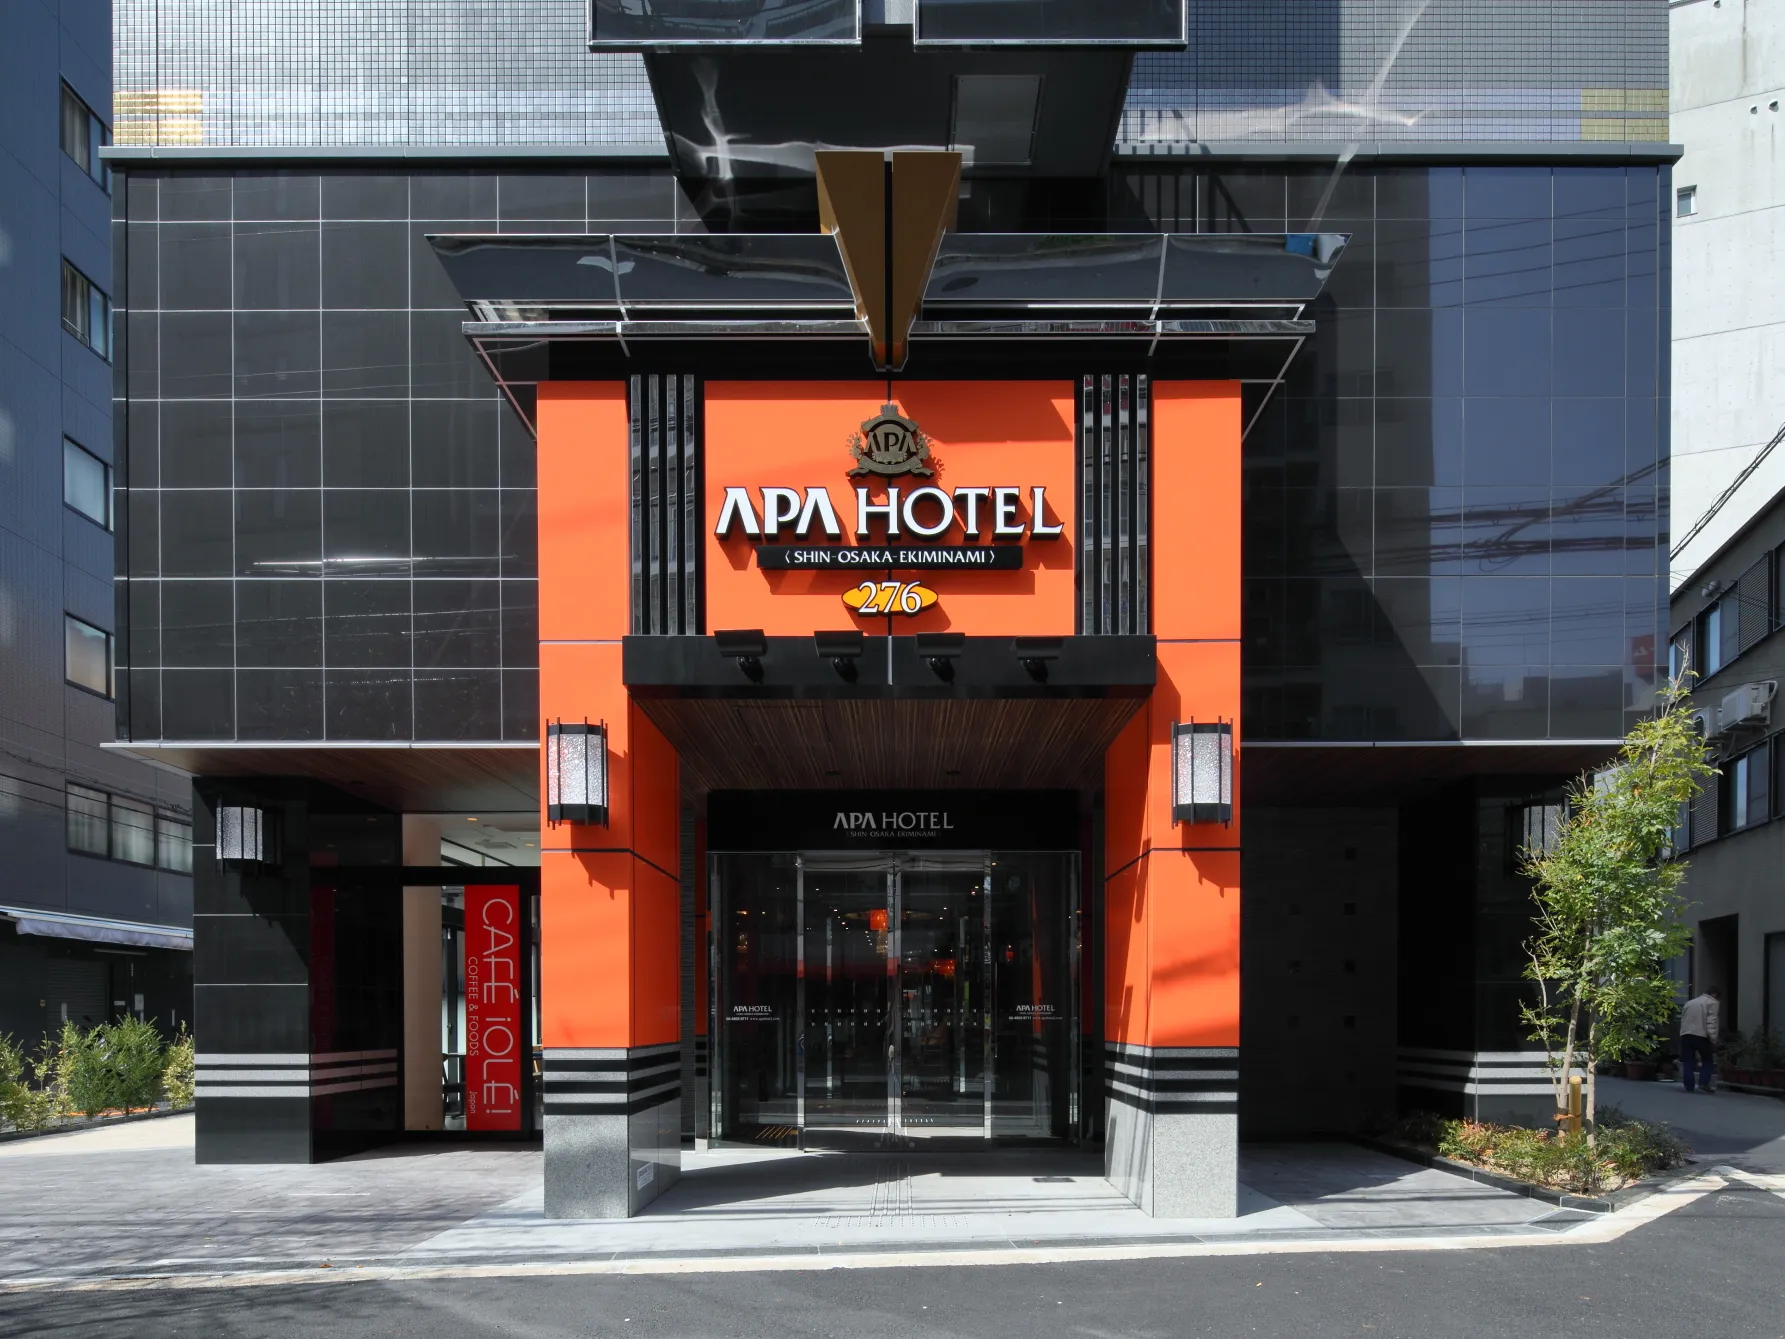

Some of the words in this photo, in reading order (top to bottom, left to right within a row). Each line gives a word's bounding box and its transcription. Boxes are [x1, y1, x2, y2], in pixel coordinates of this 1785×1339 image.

[864, 431, 917, 453] APA
[715, 486, 842, 537] APA
[855, 485, 1065, 538] HOTEL
[856, 579, 923, 615] 276
[833, 812, 877, 829] APA
[882, 812, 954, 829] HOTEL
[482, 898, 519, 1004] CAFÉ
[468, 957, 479, 999] COFFEE
[468, 1003, 478, 1012] &
[468, 1016, 479, 1056] FOODS
